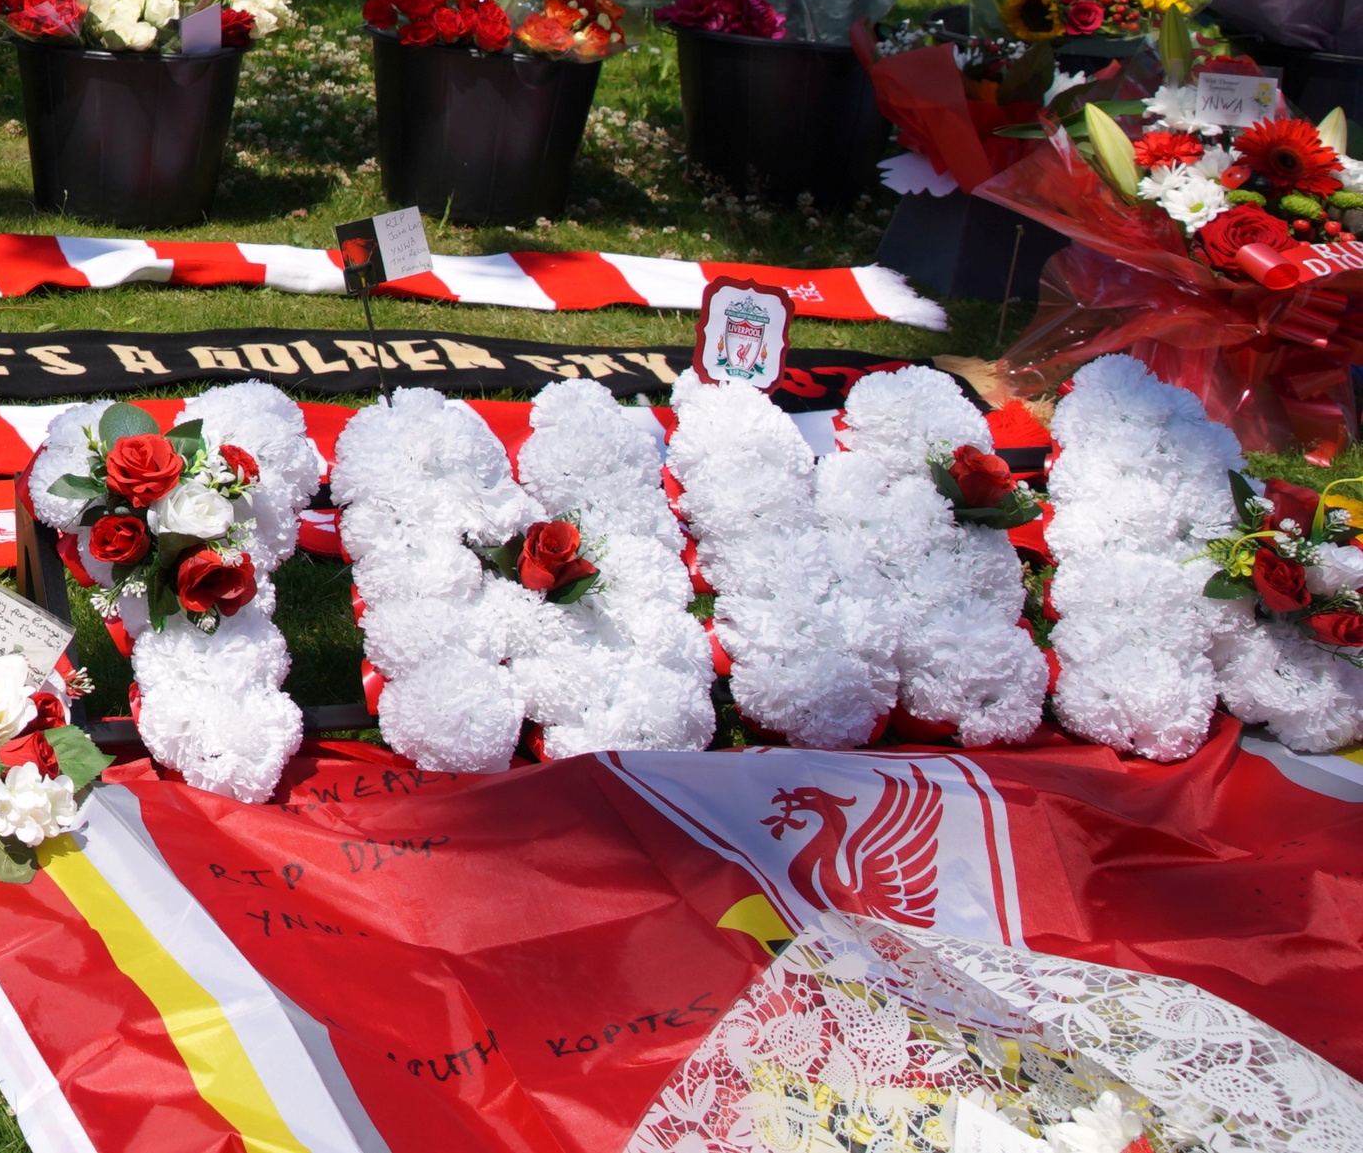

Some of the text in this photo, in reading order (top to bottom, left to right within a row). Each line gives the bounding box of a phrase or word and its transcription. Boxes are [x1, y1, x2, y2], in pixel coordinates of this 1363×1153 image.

[1202, 95, 1243, 113] YNWA
[385, 213, 405, 229] RIP
[391, 237, 416, 256] YNWA
[728, 323, 762, 338] LIVERPOOL
[107, 344, 172, 374] A
[188, 338, 505, 375] GOLDEN
[245, 910, 368, 937] YNW
